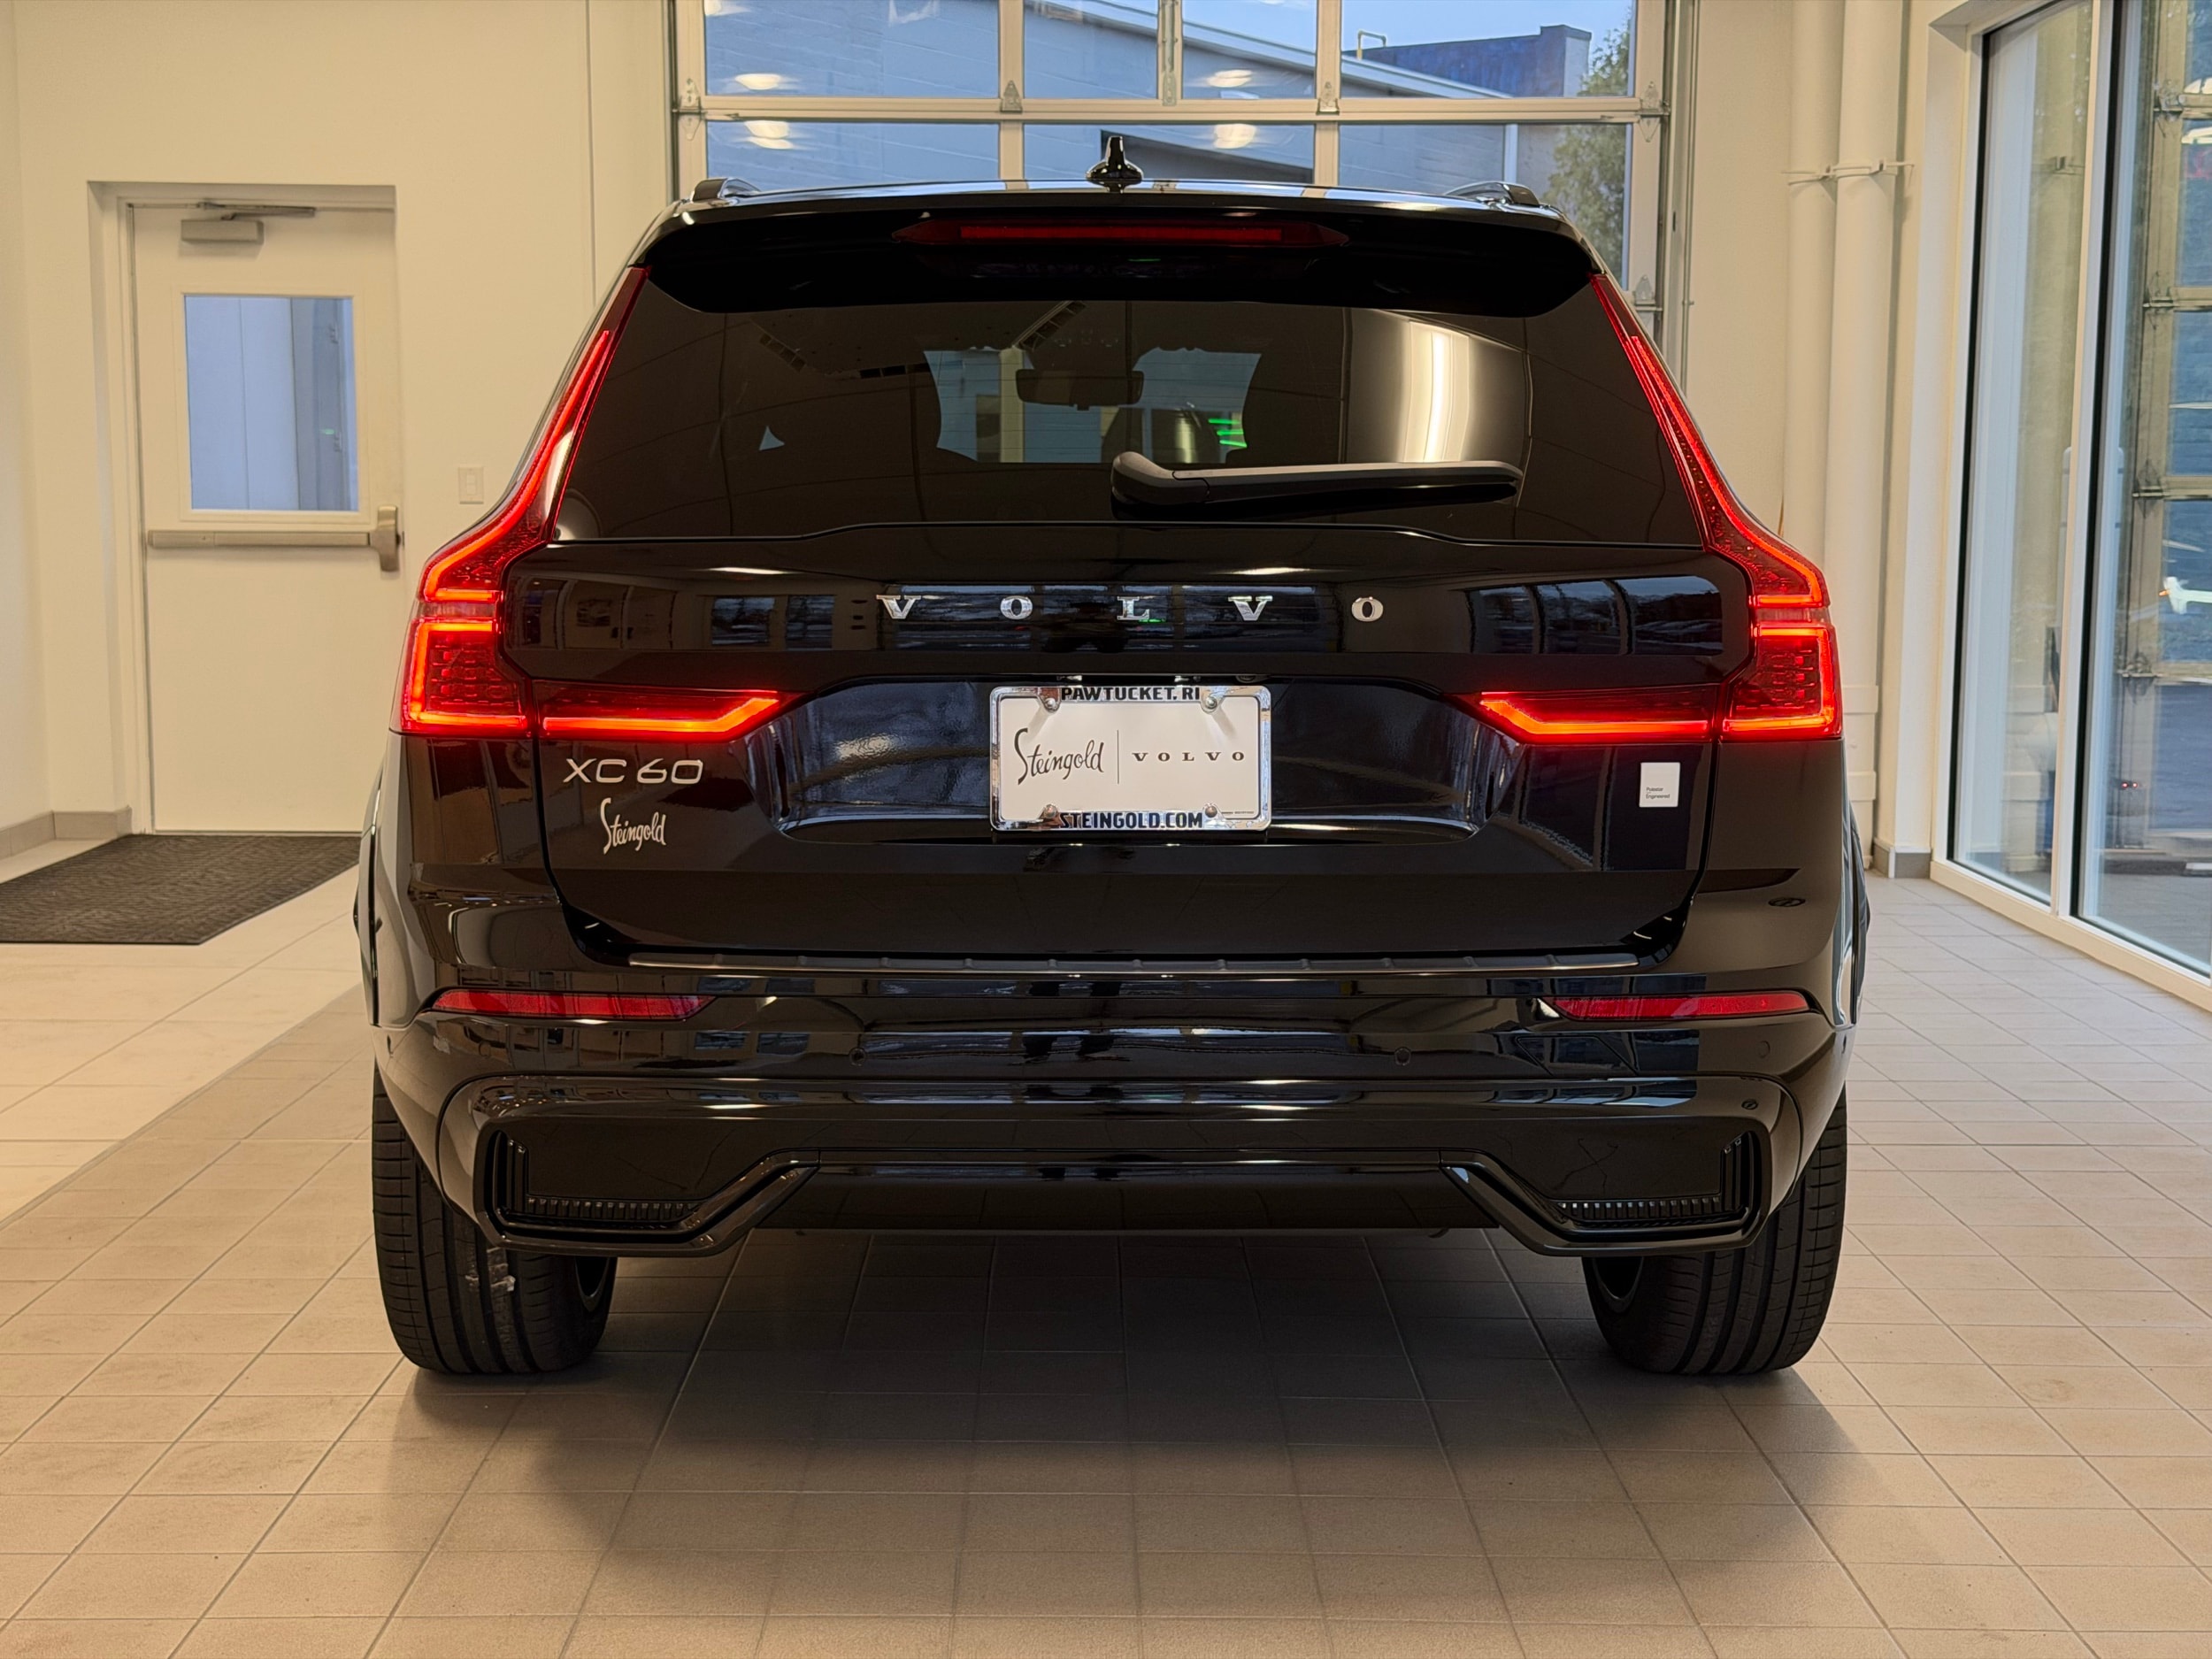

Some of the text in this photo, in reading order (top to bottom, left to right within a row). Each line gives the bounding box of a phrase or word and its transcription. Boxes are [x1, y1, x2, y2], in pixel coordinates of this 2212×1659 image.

[876, 595, 1384, 622] VOLVO
[1182, 687, 1200, 701] RI
[1014, 727, 1245, 785] Steingold VOLVO
[600, 797, 667, 855] Steingold
[1060, 811, 1203, 828] STEINGOLD.COM
